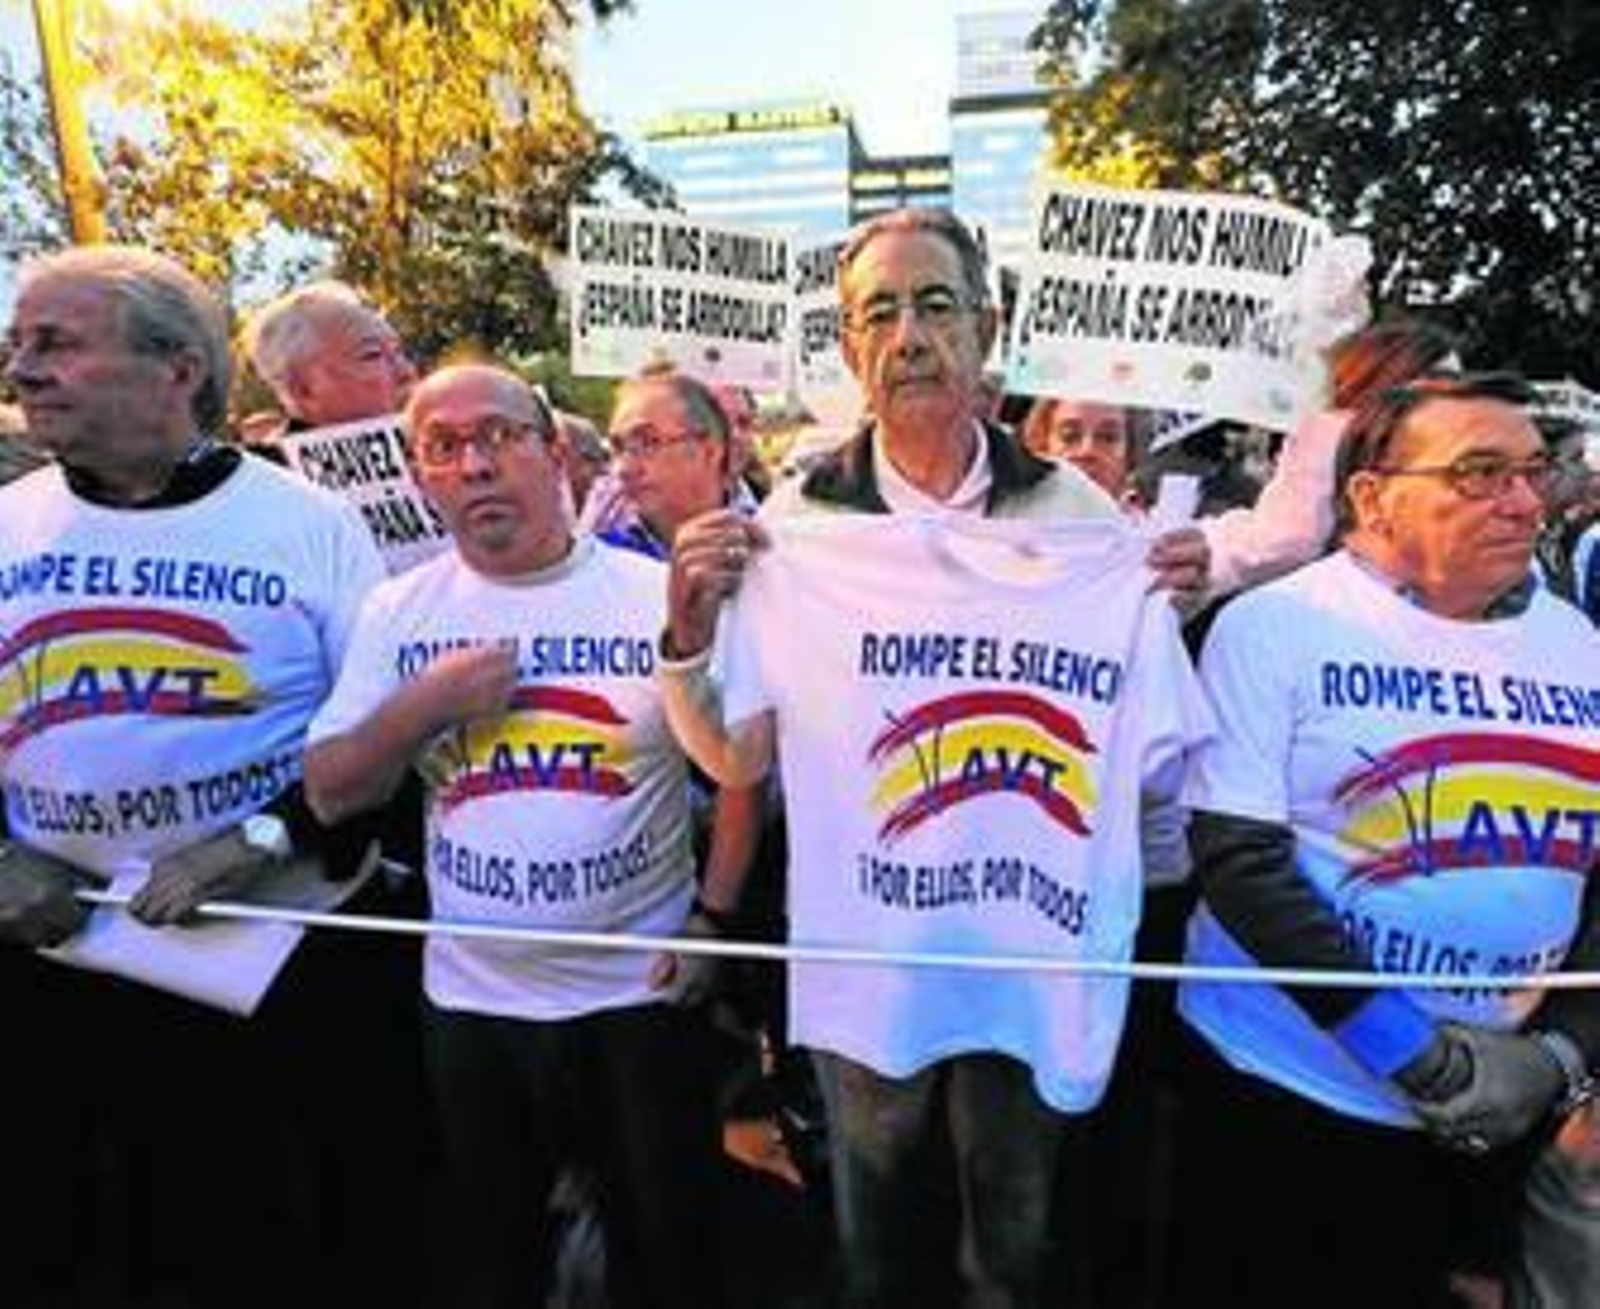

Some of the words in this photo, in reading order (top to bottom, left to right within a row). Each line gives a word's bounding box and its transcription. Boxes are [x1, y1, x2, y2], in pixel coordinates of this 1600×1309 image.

[576, 216, 654, 267] CHAVEZ
[660, 224, 701, 272] NOS
[704, 230, 788, 284] HUMILLA
[1039, 193, 1146, 253] CHAVEZ
[1145, 205, 1209, 266] NOS
[660, 286, 683, 333] SE
[1131, 280, 1169, 343] SE
[299, 429, 401, 491] CHAVEZ
[360, 487, 430, 549] PAÑA
[0, 552, 76, 600] OMPE
[84, 556, 120, 597] EL
[130, 556, 286, 607] SILENCIO
[532, 636, 654, 678] SILENCIO
[860, 632, 968, 679] ROMPE
[971, 637, 1002, 680] EL
[66, 664, 219, 713] AVT
[1321, 662, 1449, 716] ROMPE
[1452, 671, 1497, 720] EL
[489, 742, 606, 788] AVT
[961, 746, 1068, 793] AVT
[115, 787, 182, 830] POR
[1458, 800, 1600, 866] AVT
[528, 861, 577, 903] POR
[981, 856, 1024, 901] POR
